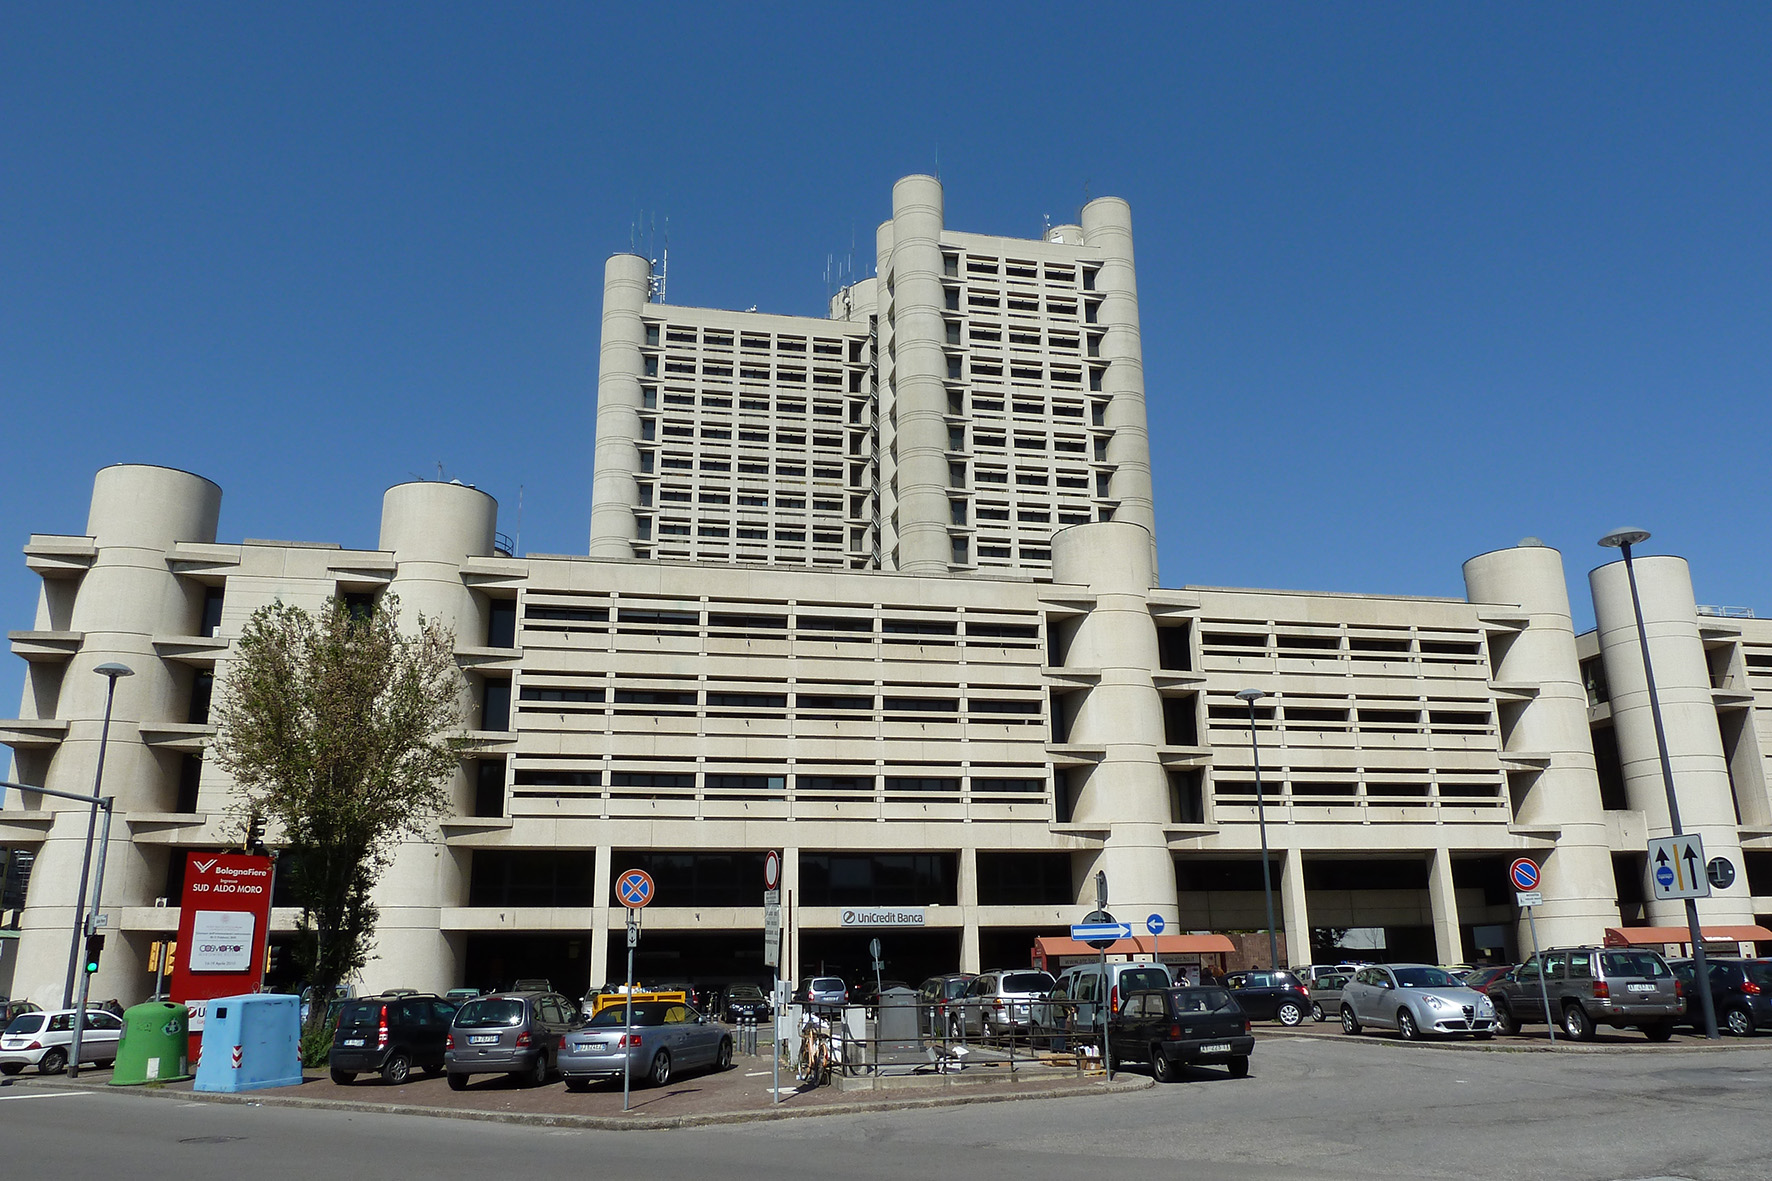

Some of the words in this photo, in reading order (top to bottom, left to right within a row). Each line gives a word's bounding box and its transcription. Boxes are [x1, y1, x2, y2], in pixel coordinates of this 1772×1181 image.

[215, 866, 267, 877] BolognaFiere
[193, 883, 210, 892] SUD
[213, 884, 236, 893] ALDO
[237, 885, 263, 894] MORO
[858, 911, 896, 923] UniCredit
[897, 912, 923, 923] Banca
